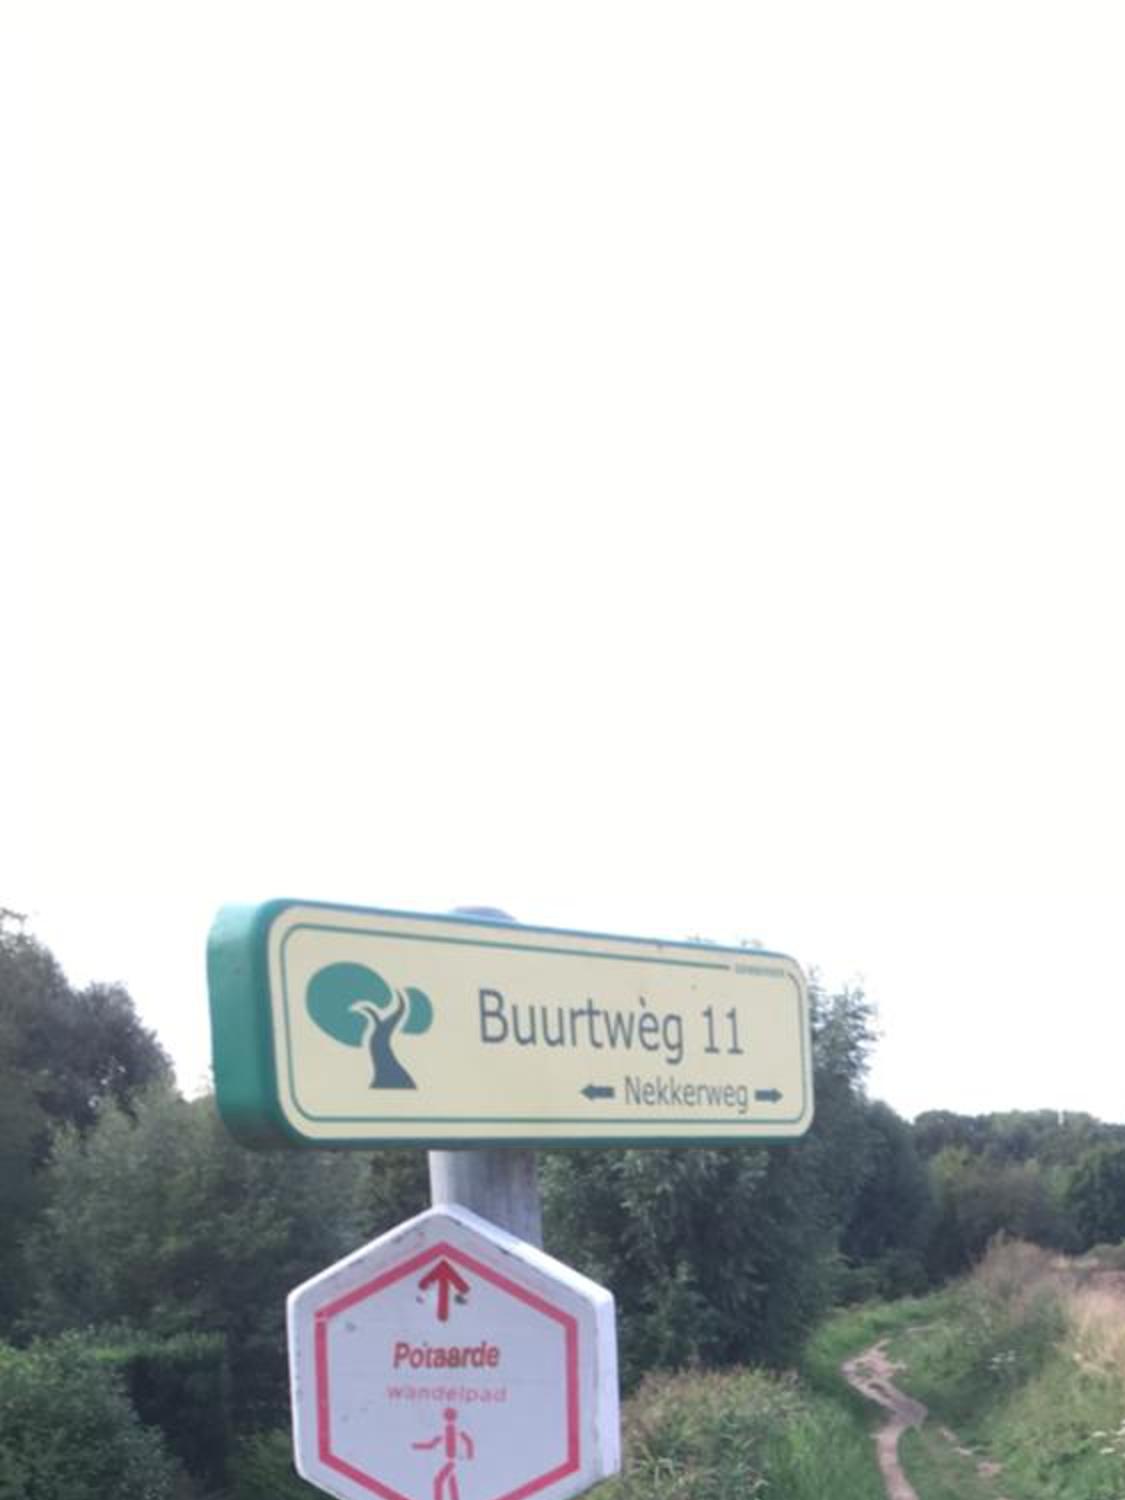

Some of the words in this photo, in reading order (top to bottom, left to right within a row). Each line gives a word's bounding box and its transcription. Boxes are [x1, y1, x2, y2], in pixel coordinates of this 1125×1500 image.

[701, 1005, 744, 1055] 11
[624, 1075, 749, 1115] Nekkerweg
[386, 1385, 507, 1403] wandelpad
